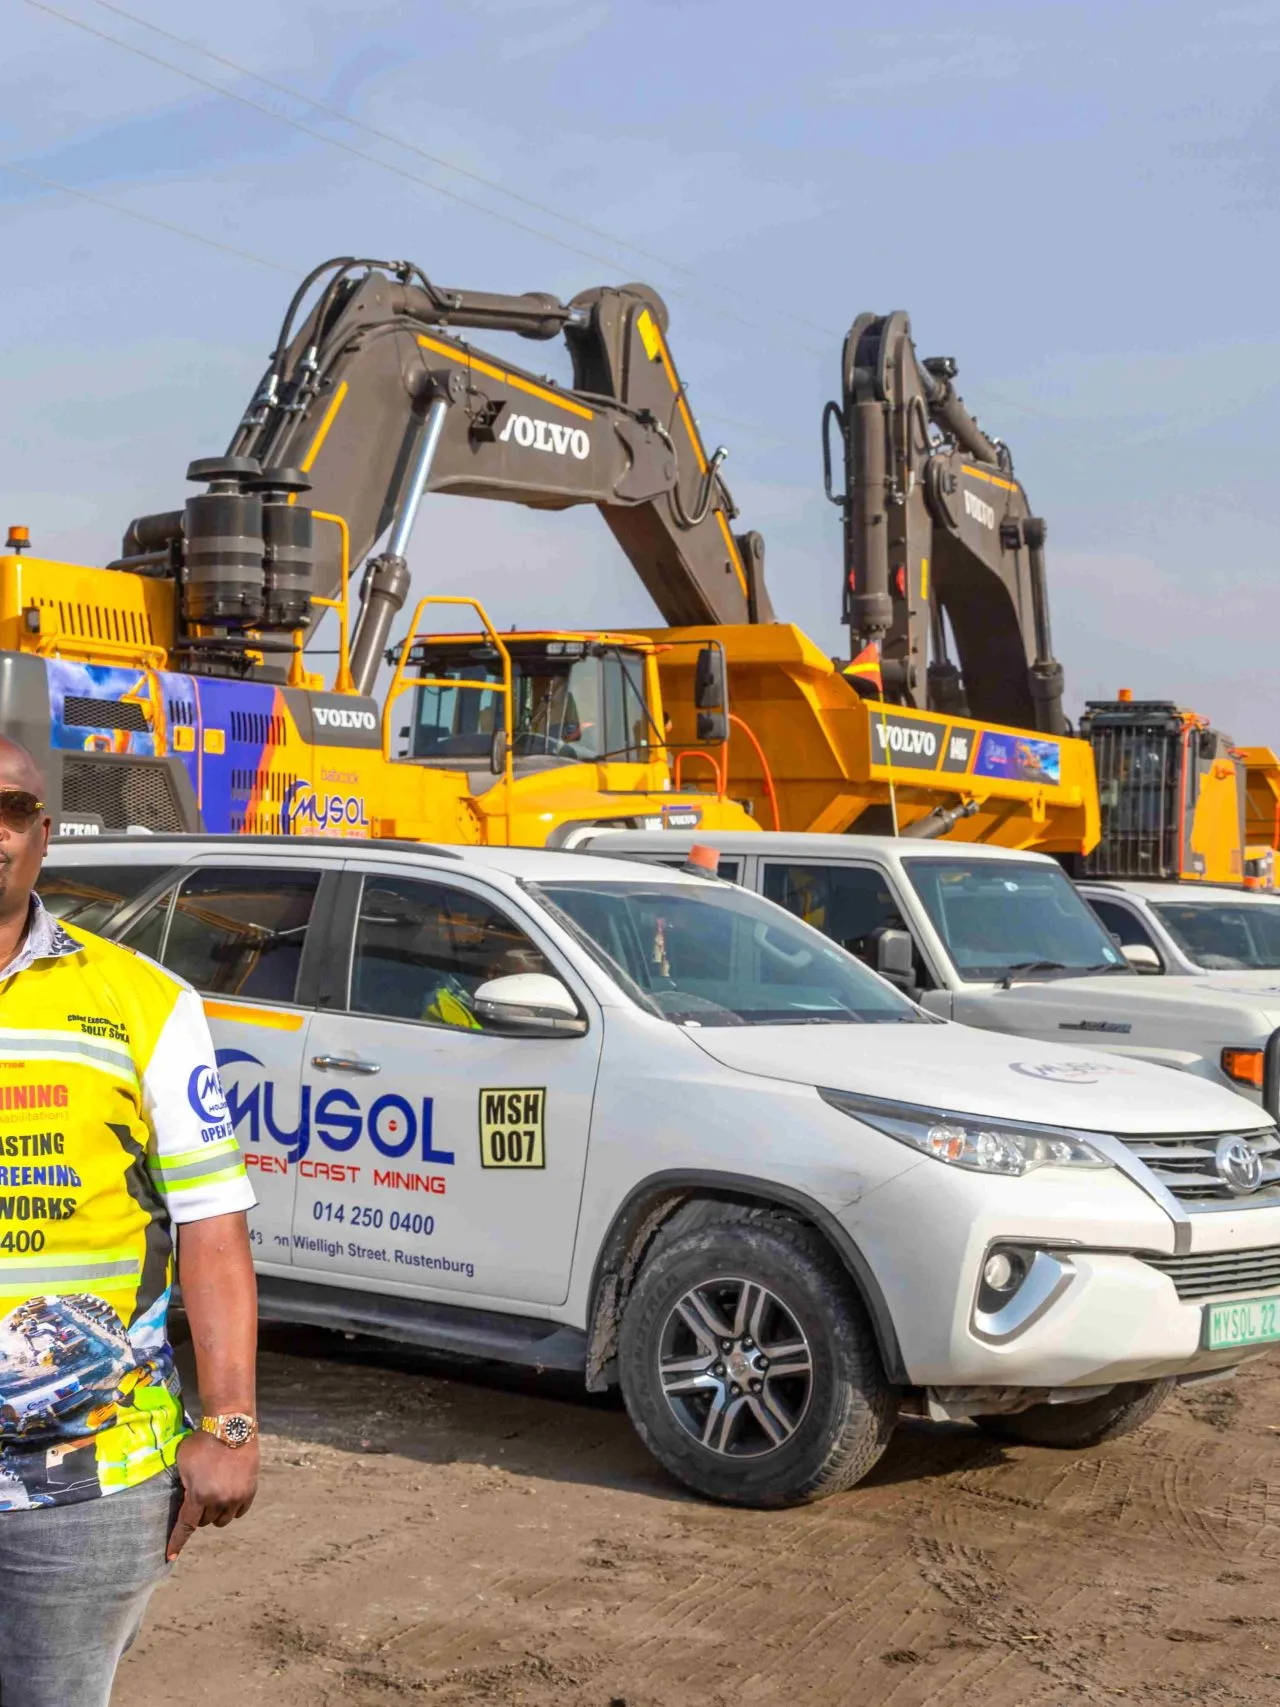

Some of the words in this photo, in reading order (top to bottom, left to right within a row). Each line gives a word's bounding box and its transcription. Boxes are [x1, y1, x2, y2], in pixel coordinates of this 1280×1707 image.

[312, 707, 376, 730] VOLVO
[875, 723, 937, 756] VOLVO
[81, 1023, 107, 1037] SOLLY
[485, 1094, 539, 1125] MSH
[200, 1123, 227, 1143] OPEN
[490, 1130, 536, 1163] 007
[243, 1152, 287, 1175] PEN
[300, 1159, 360, 1184] CAST
[374, 1168, 446, 1195] MINING
[313, 1201, 345, 1223] 014
[350, 1206, 383, 1229] 250
[389, 1211, 434, 1235] 0400
[293, 1235, 344, 1258] Wielligh
[394, 1249, 475, 1278] Rustenburg
